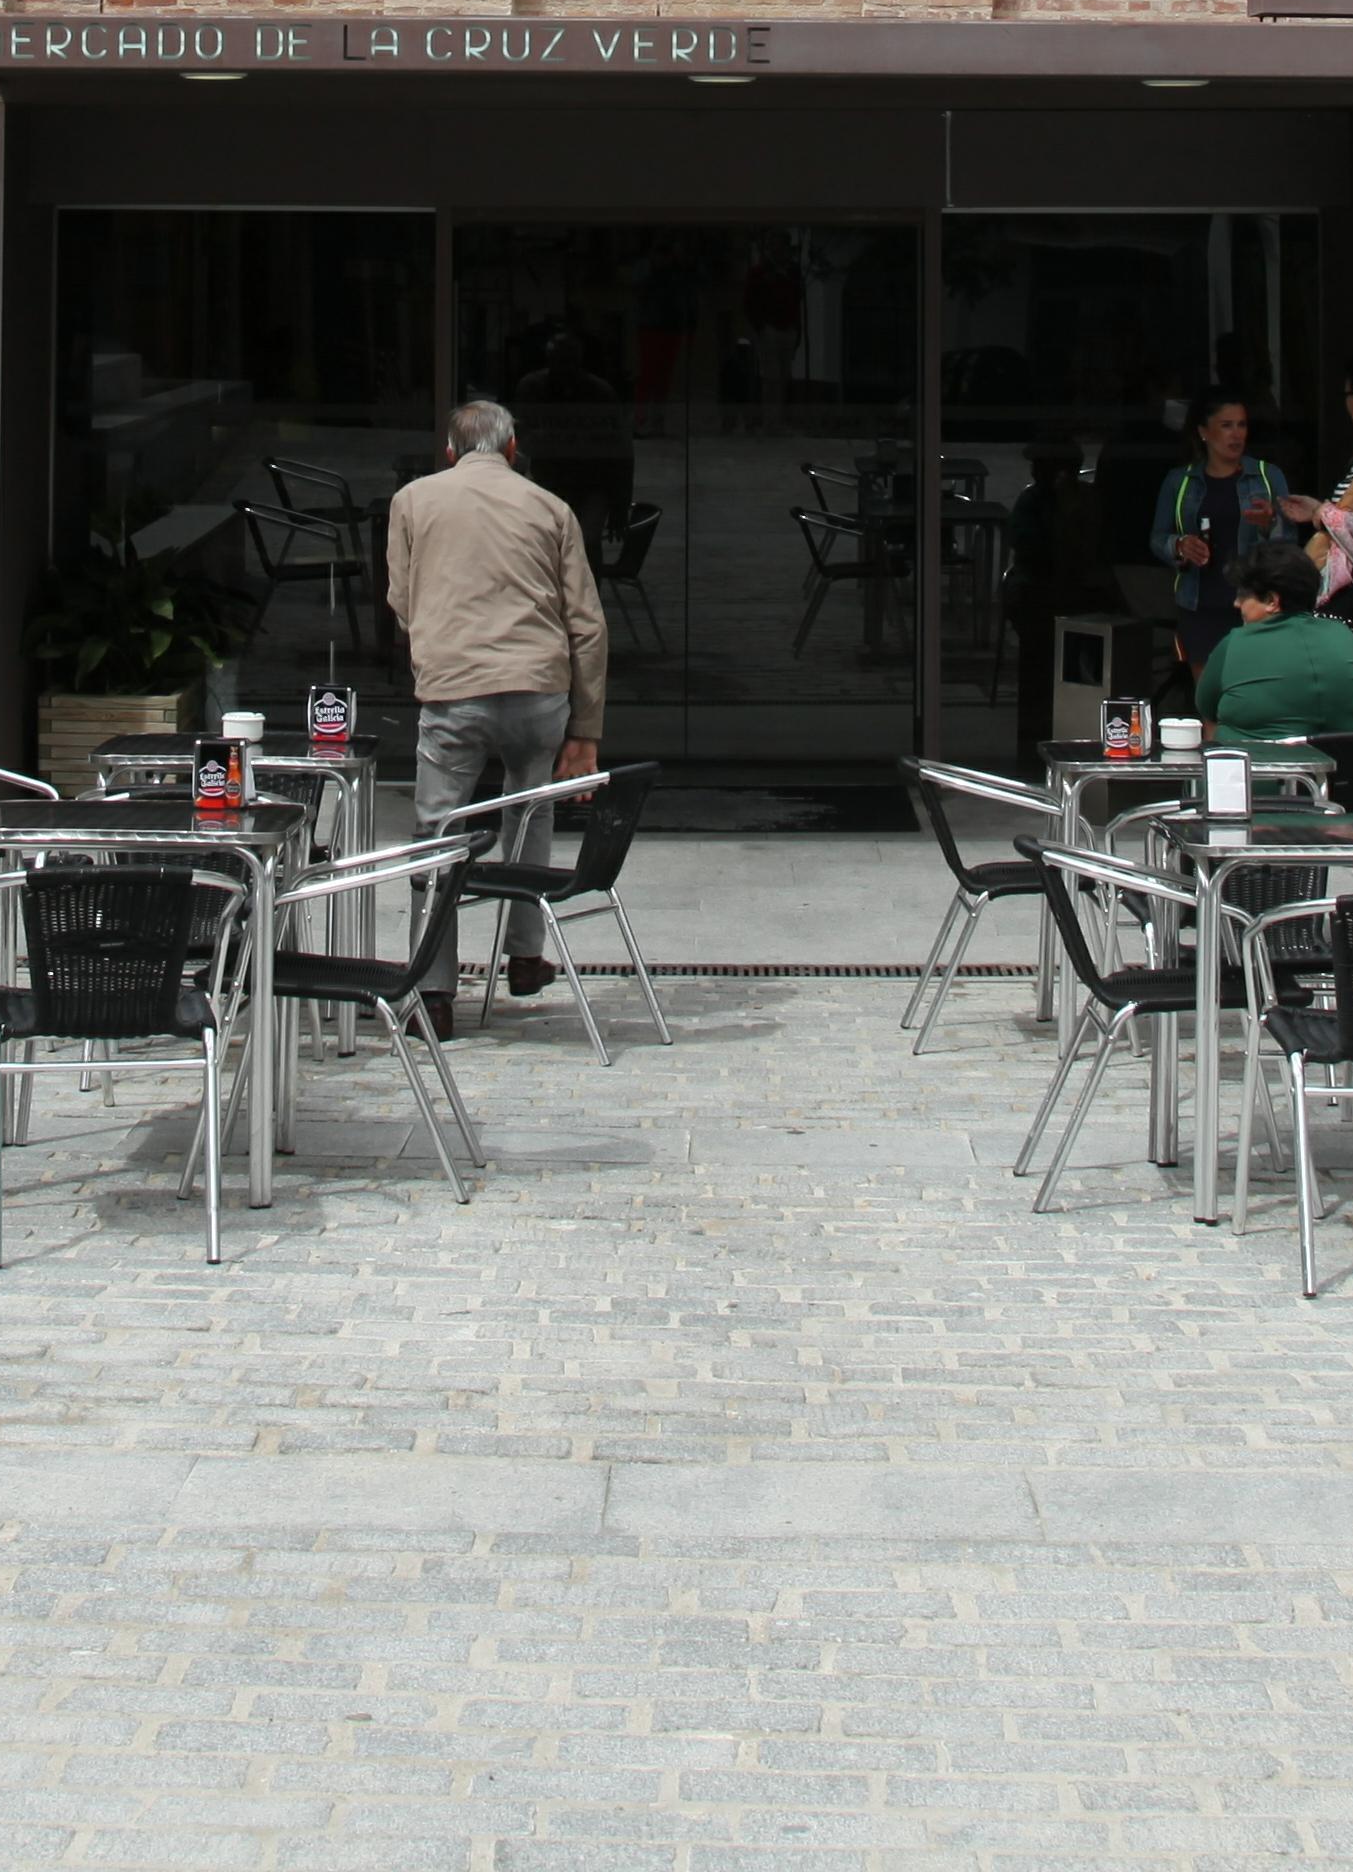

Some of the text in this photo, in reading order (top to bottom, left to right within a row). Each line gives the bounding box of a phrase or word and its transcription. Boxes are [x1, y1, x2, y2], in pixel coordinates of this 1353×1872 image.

[256, 23, 313, 61] DE
[342, 24, 400, 62] LA
[424, 27, 568, 63] CRUZ
[591, 28, 771, 65] VERDE
